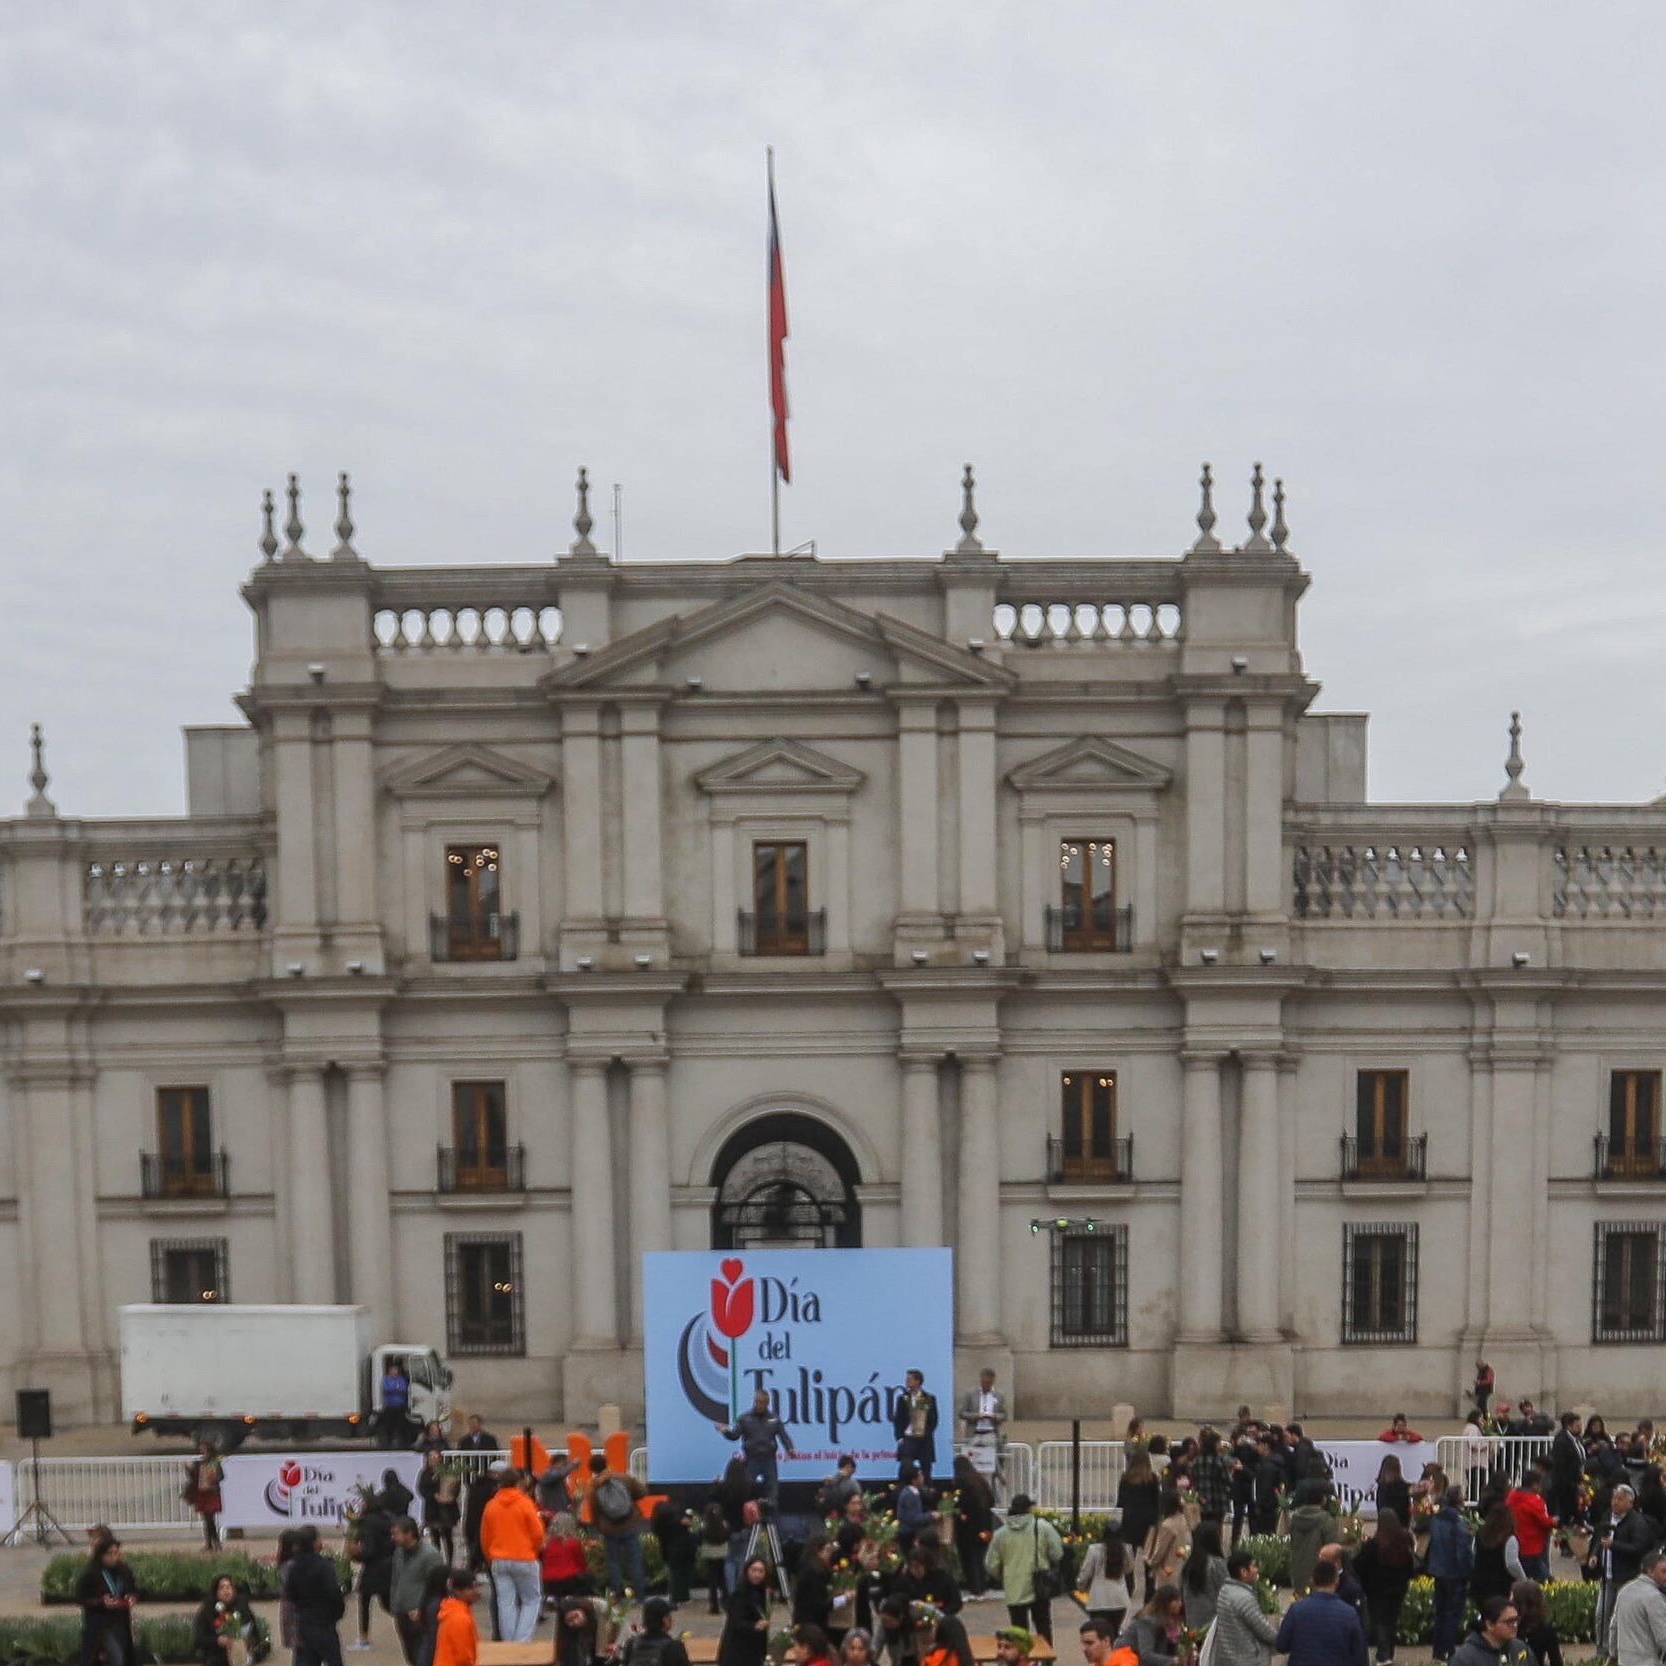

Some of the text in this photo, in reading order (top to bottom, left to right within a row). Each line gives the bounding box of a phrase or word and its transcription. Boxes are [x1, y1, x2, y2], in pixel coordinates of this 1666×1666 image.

[760, 1275, 822, 1324] Día
[757, 1331, 792, 1361] del
[743, 1366, 907, 1444] Tulipán
[305, 1464, 334, 1483] Día
[303, 1485, 319, 1495] del
[300, 1496, 348, 1524] Tulip
